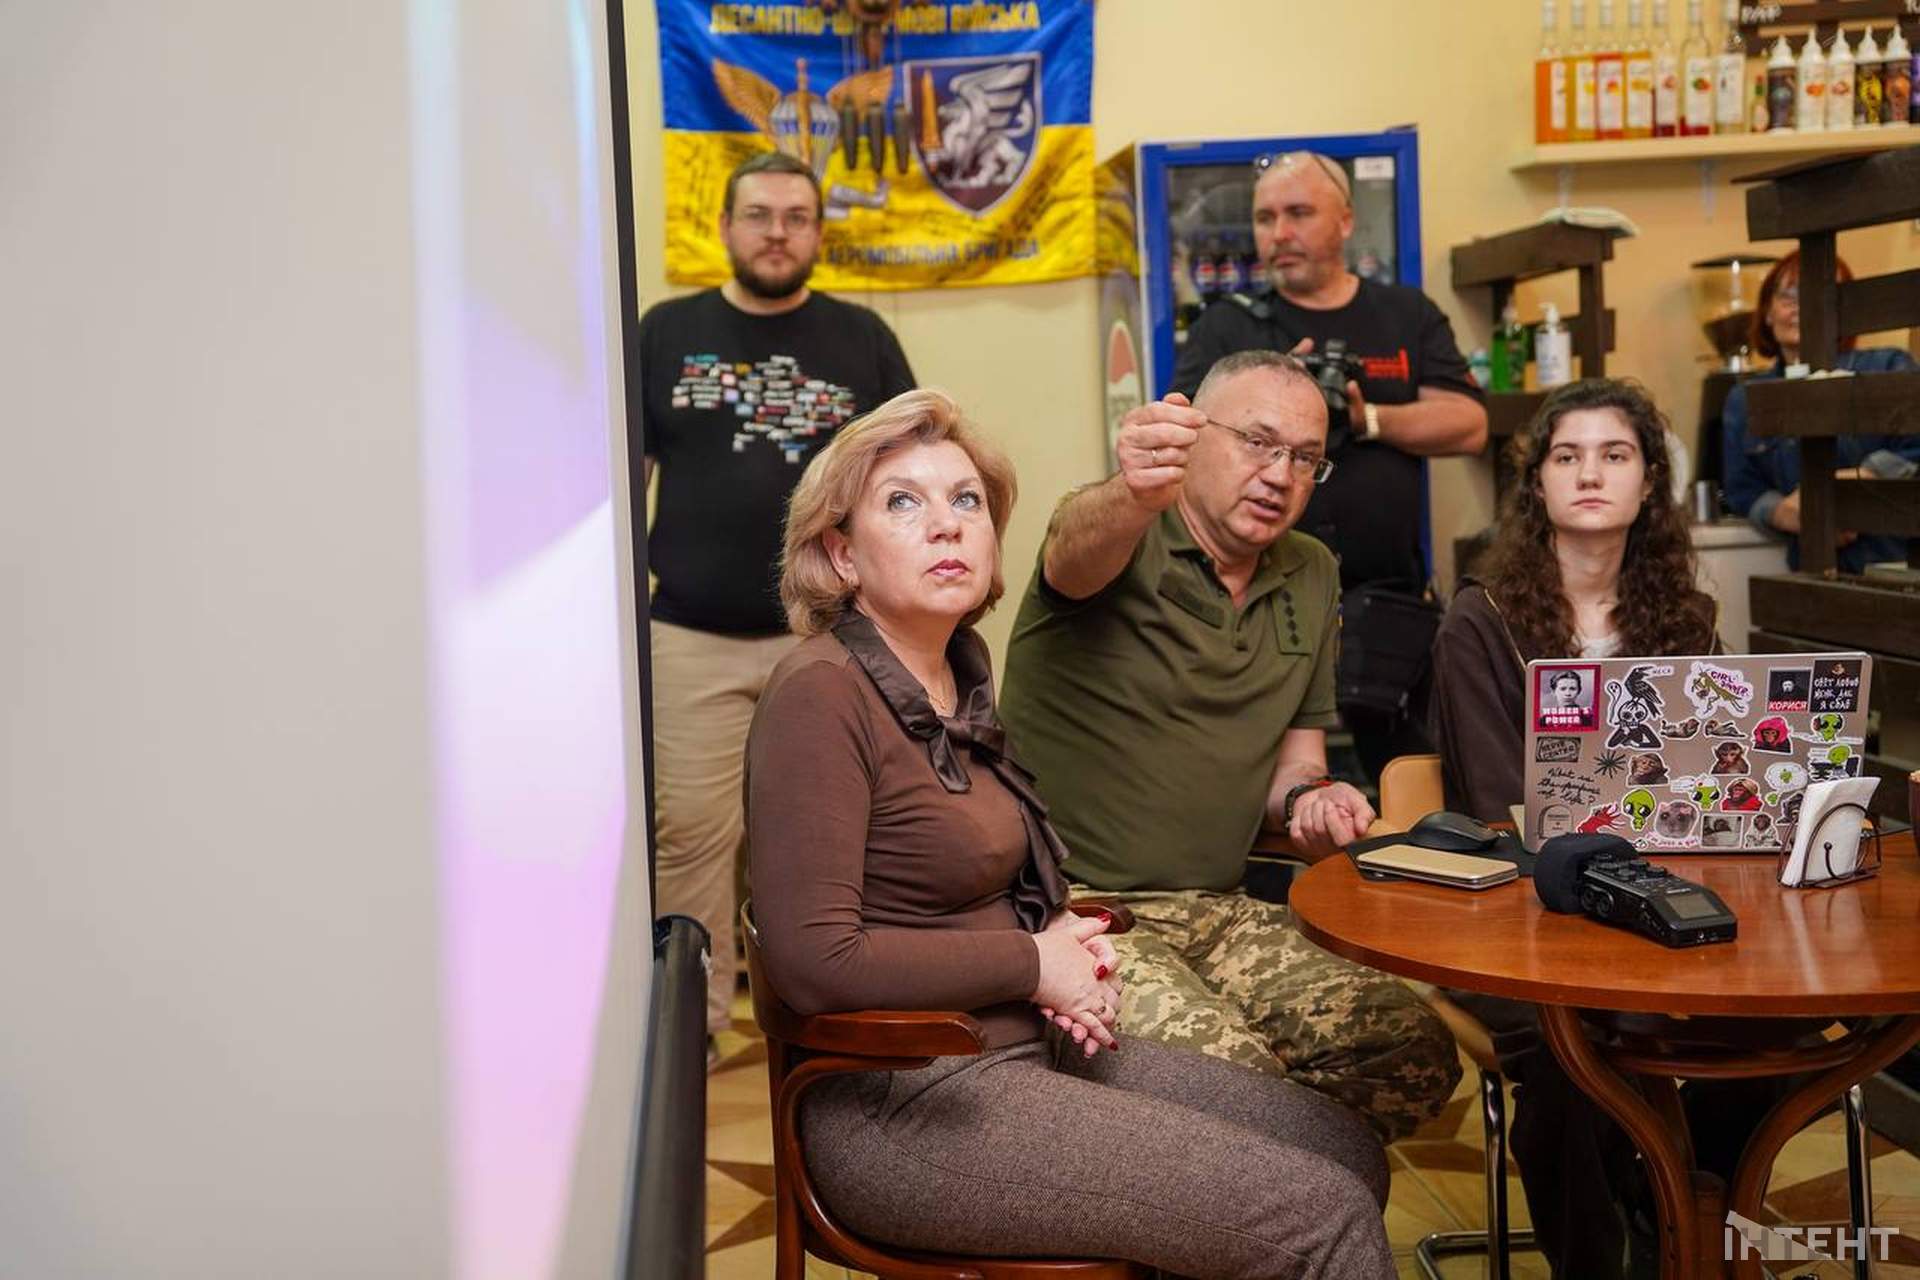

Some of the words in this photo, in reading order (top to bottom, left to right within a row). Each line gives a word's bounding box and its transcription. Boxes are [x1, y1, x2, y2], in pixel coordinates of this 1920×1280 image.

[710, 5, 947, 35] ДЕСАНТНО-ШМОВІ
[951, 1, 1041, 32] ВІЙСЬКА
[1767, 701, 1808, 711] КОРИСЯ
[1545, 716, 1581, 725] POWER
